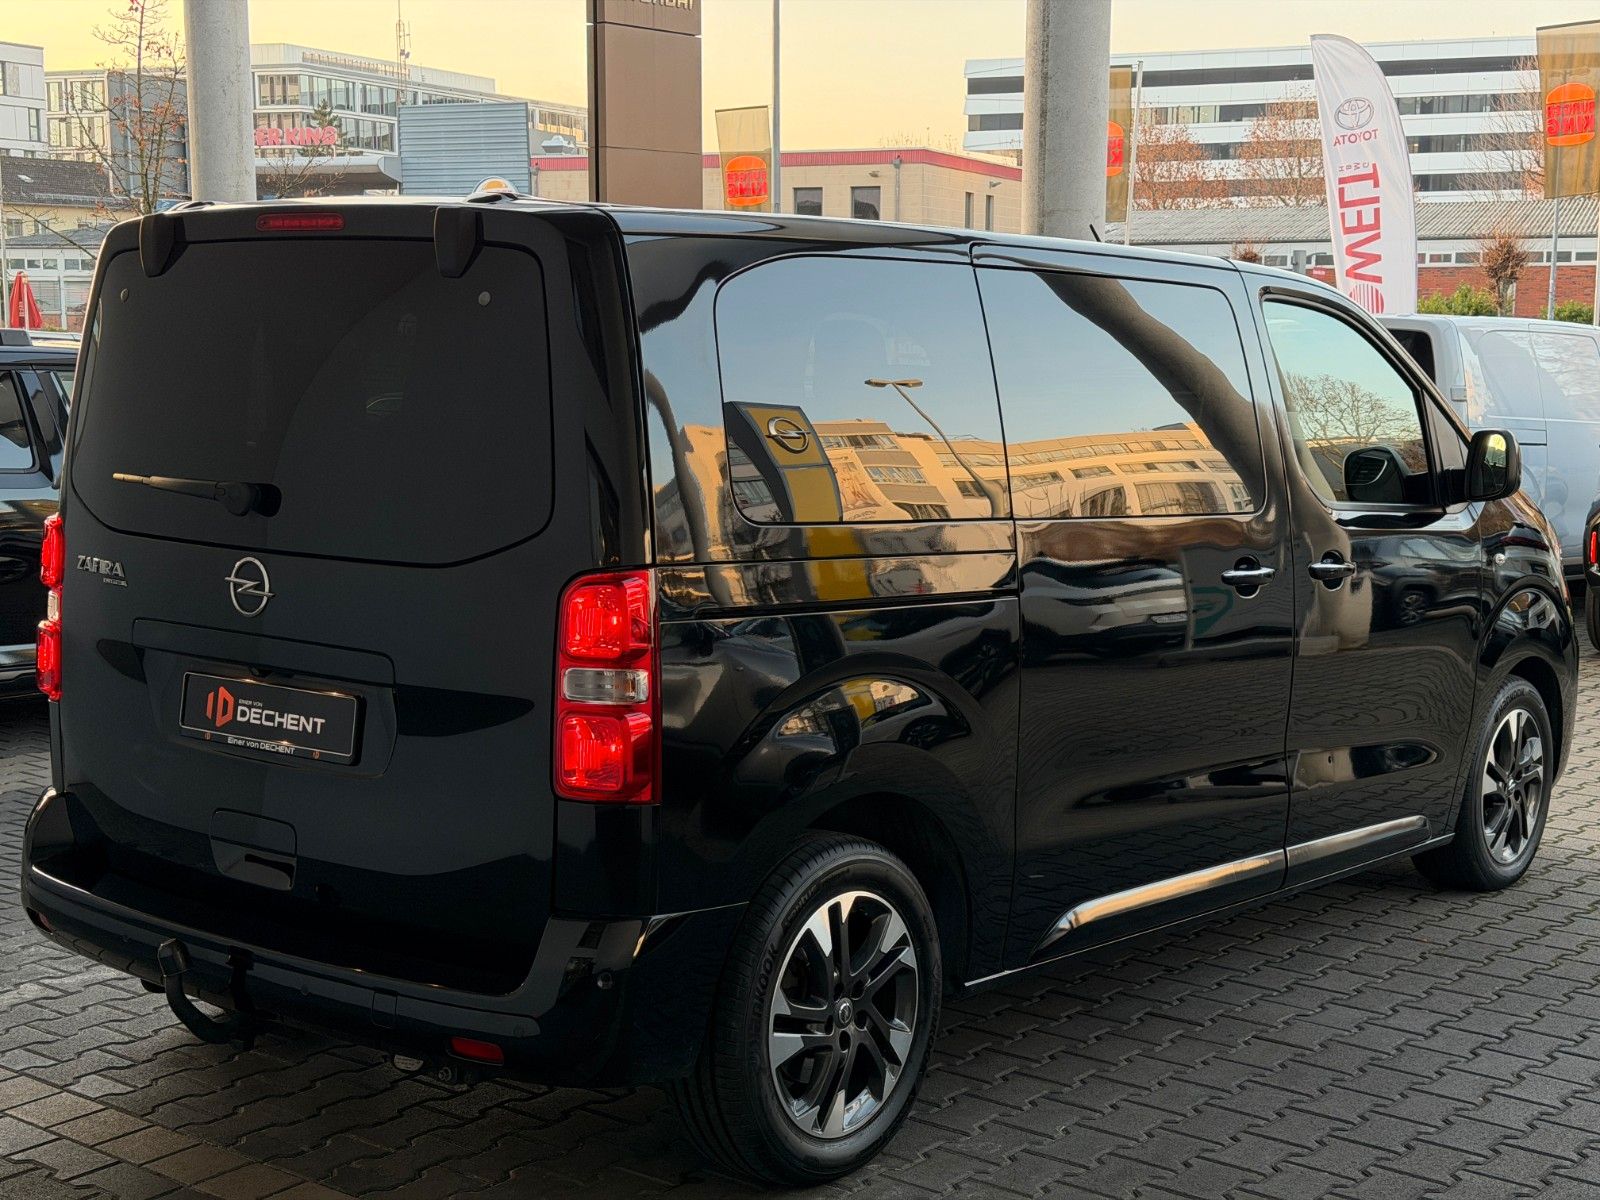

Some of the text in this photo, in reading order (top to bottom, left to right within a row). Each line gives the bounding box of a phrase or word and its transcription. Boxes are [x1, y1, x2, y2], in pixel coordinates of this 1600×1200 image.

[285, 126, 337, 146] KING
[77, 555, 125, 578] ZAFIRA
[236, 705, 326, 735] DECHENT
[228, 736, 295, 755] Einer von DECHENT
